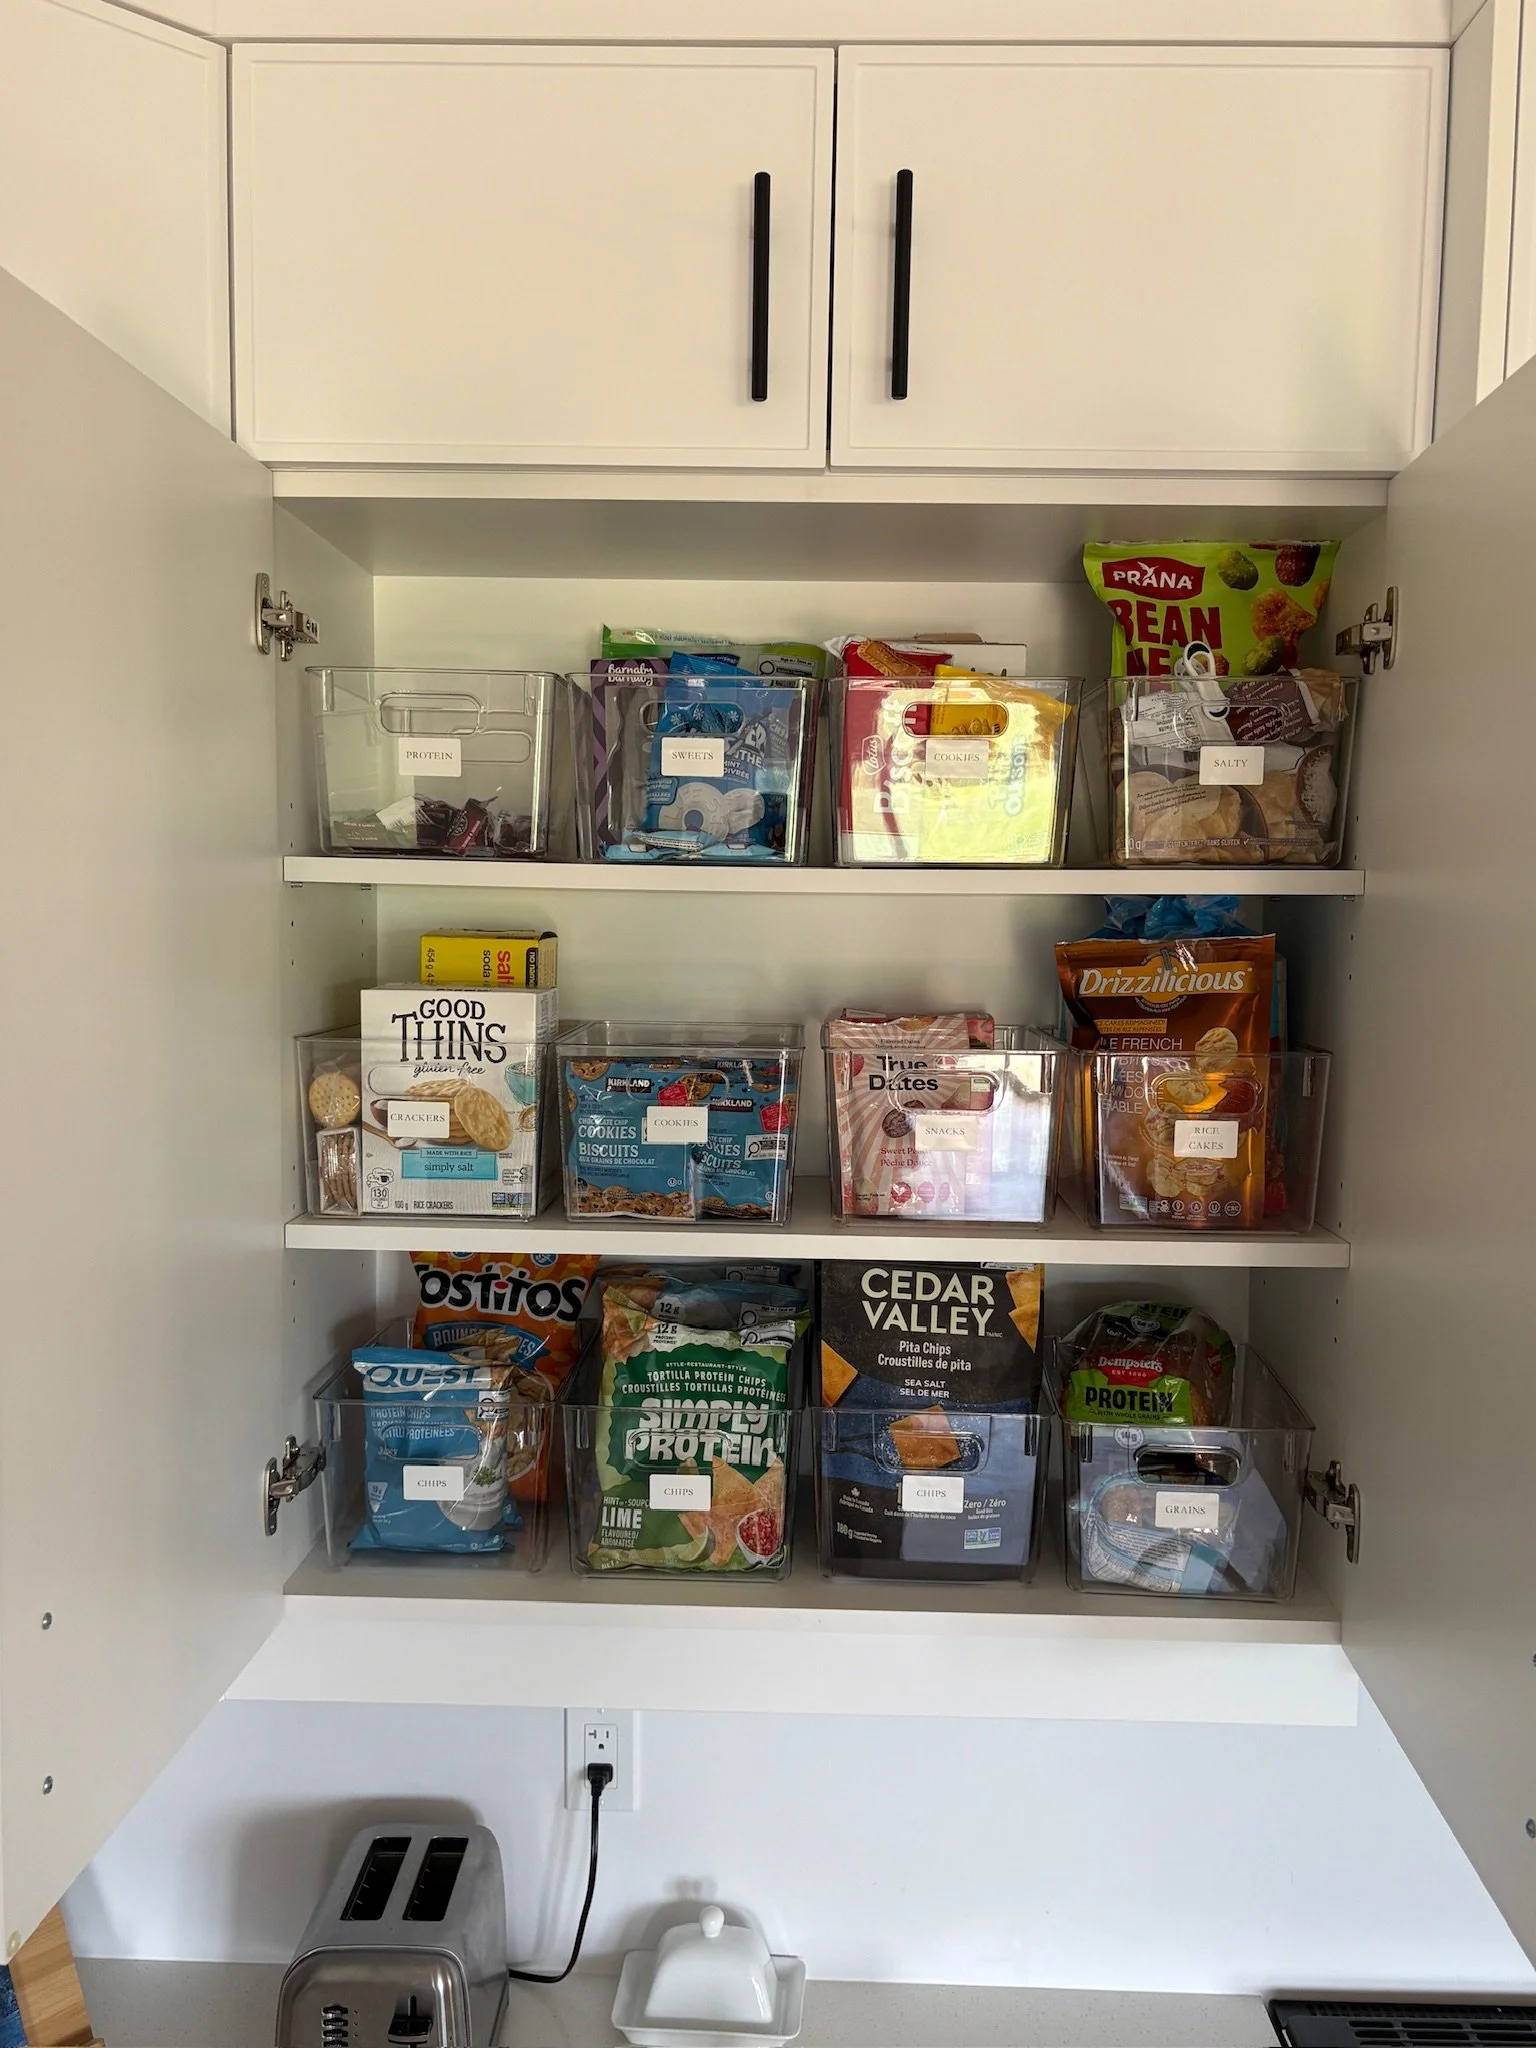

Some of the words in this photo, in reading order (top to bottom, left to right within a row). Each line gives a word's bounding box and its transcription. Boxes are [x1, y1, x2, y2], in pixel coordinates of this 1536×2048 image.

[1113, 568, 1194, 590] PRANA
[1107, 599, 1222, 649] BEAN
[608, 663, 654, 687] Barnaby
[405, 751, 454, 760] PROTEIN
[671, 751, 714, 760] SWEETS
[866, 738, 880, 769] Lotus
[934, 752, 980, 762] COOKIES
[1213, 759, 1249, 768] SALTY
[427, 947, 436, 963] 454
[528, 951, 536, 963] no
[483, 949, 492, 978] soda
[1079, 967, 1246, 995] Drizzilicious
[419, 998, 486, 1020] GOOD
[391, 1011, 507, 1064] THINS
[1122, 1038, 1183, 1050] FRENCH
[877, 1055, 928, 1071] True
[608, 1078, 650, 1088] KIRKLAND
[869, 1074, 939, 1091] Dates
[390, 1113, 446, 1122] CRACKERS
[578, 1118, 613, 1126] CHOCLATE
[654, 1118, 699, 1127] COOKIES
[578, 1125, 637, 1139] COOKIES
[925, 1127, 966, 1136] SNACKS
[1194, 1127, 1220, 1135] RICE
[579, 1142, 639, 1157] BISCUITS
[692, 1141, 741, 1157] OOKIES
[880, 1147, 906, 1155] Sweet
[1188, 1141, 1224, 1150] CAKES
[424, 1161, 454, 1173] simply
[457, 1161, 474, 1172] salt
[880, 1158, 905, 1167] Pêche
[373, 1188, 387, 1198] 130
[413, 1200, 425, 1209] RICE
[426, 1200, 454, 1210] CRACKERS
[861, 1268, 996, 1305] CEDAR
[659, 1302, 672, 1313] 12
[673, 1306, 681, 1315] g
[861, 1300, 995, 1337] VALLEY
[657, 1323, 669, 1334] 12
[670, 1324, 678, 1334] g
[899, 1340, 920, 1354] Pita
[922, 1341, 951, 1356] Chips
[878, 1353, 933, 1369] Croustilles
[935, 1357, 948, 1369] de
[950, 1358, 972, 1372] pita
[1098, 1356, 1164, 1373] Dempster's
[366, 1365, 482, 1388] QUEST
[647, 1370, 690, 1382] TORTILLA
[694, 1372, 735, 1383] PROTEIN
[738, 1375, 767, 1387] CHIPS
[621, 1382, 681, 1394] CROUSTILLES
[684, 1382, 733, 1394] TORTILLAS
[904, 1378, 922, 1387] SEA
[923, 1379, 946, 1388] SALT
[900, 1387, 916, 1396] SEL
[917, 1388, 930, 1397] DE
[931, 1389, 950, 1398] MER
[1085, 1386, 1174, 1412] PROTEIN
[638, 1397, 770, 1434] SIMPLY
[624, 1428, 778, 1468] PROTEIN
[417, 1480, 447, 1488] CHIPS
[663, 1487, 694, 1496] CHIPS
[916, 1489, 947, 1498] CHIPS
[603, 1495, 619, 1505] HINT
[627, 1498, 650, 1508] SOUPÇ
[964, 1500, 982, 1509] Zero
[989, 1498, 1007, 1507] Zéro
[1165, 1504, 1206, 1515] GRAINS
[601, 1506, 642, 1529] LIME
